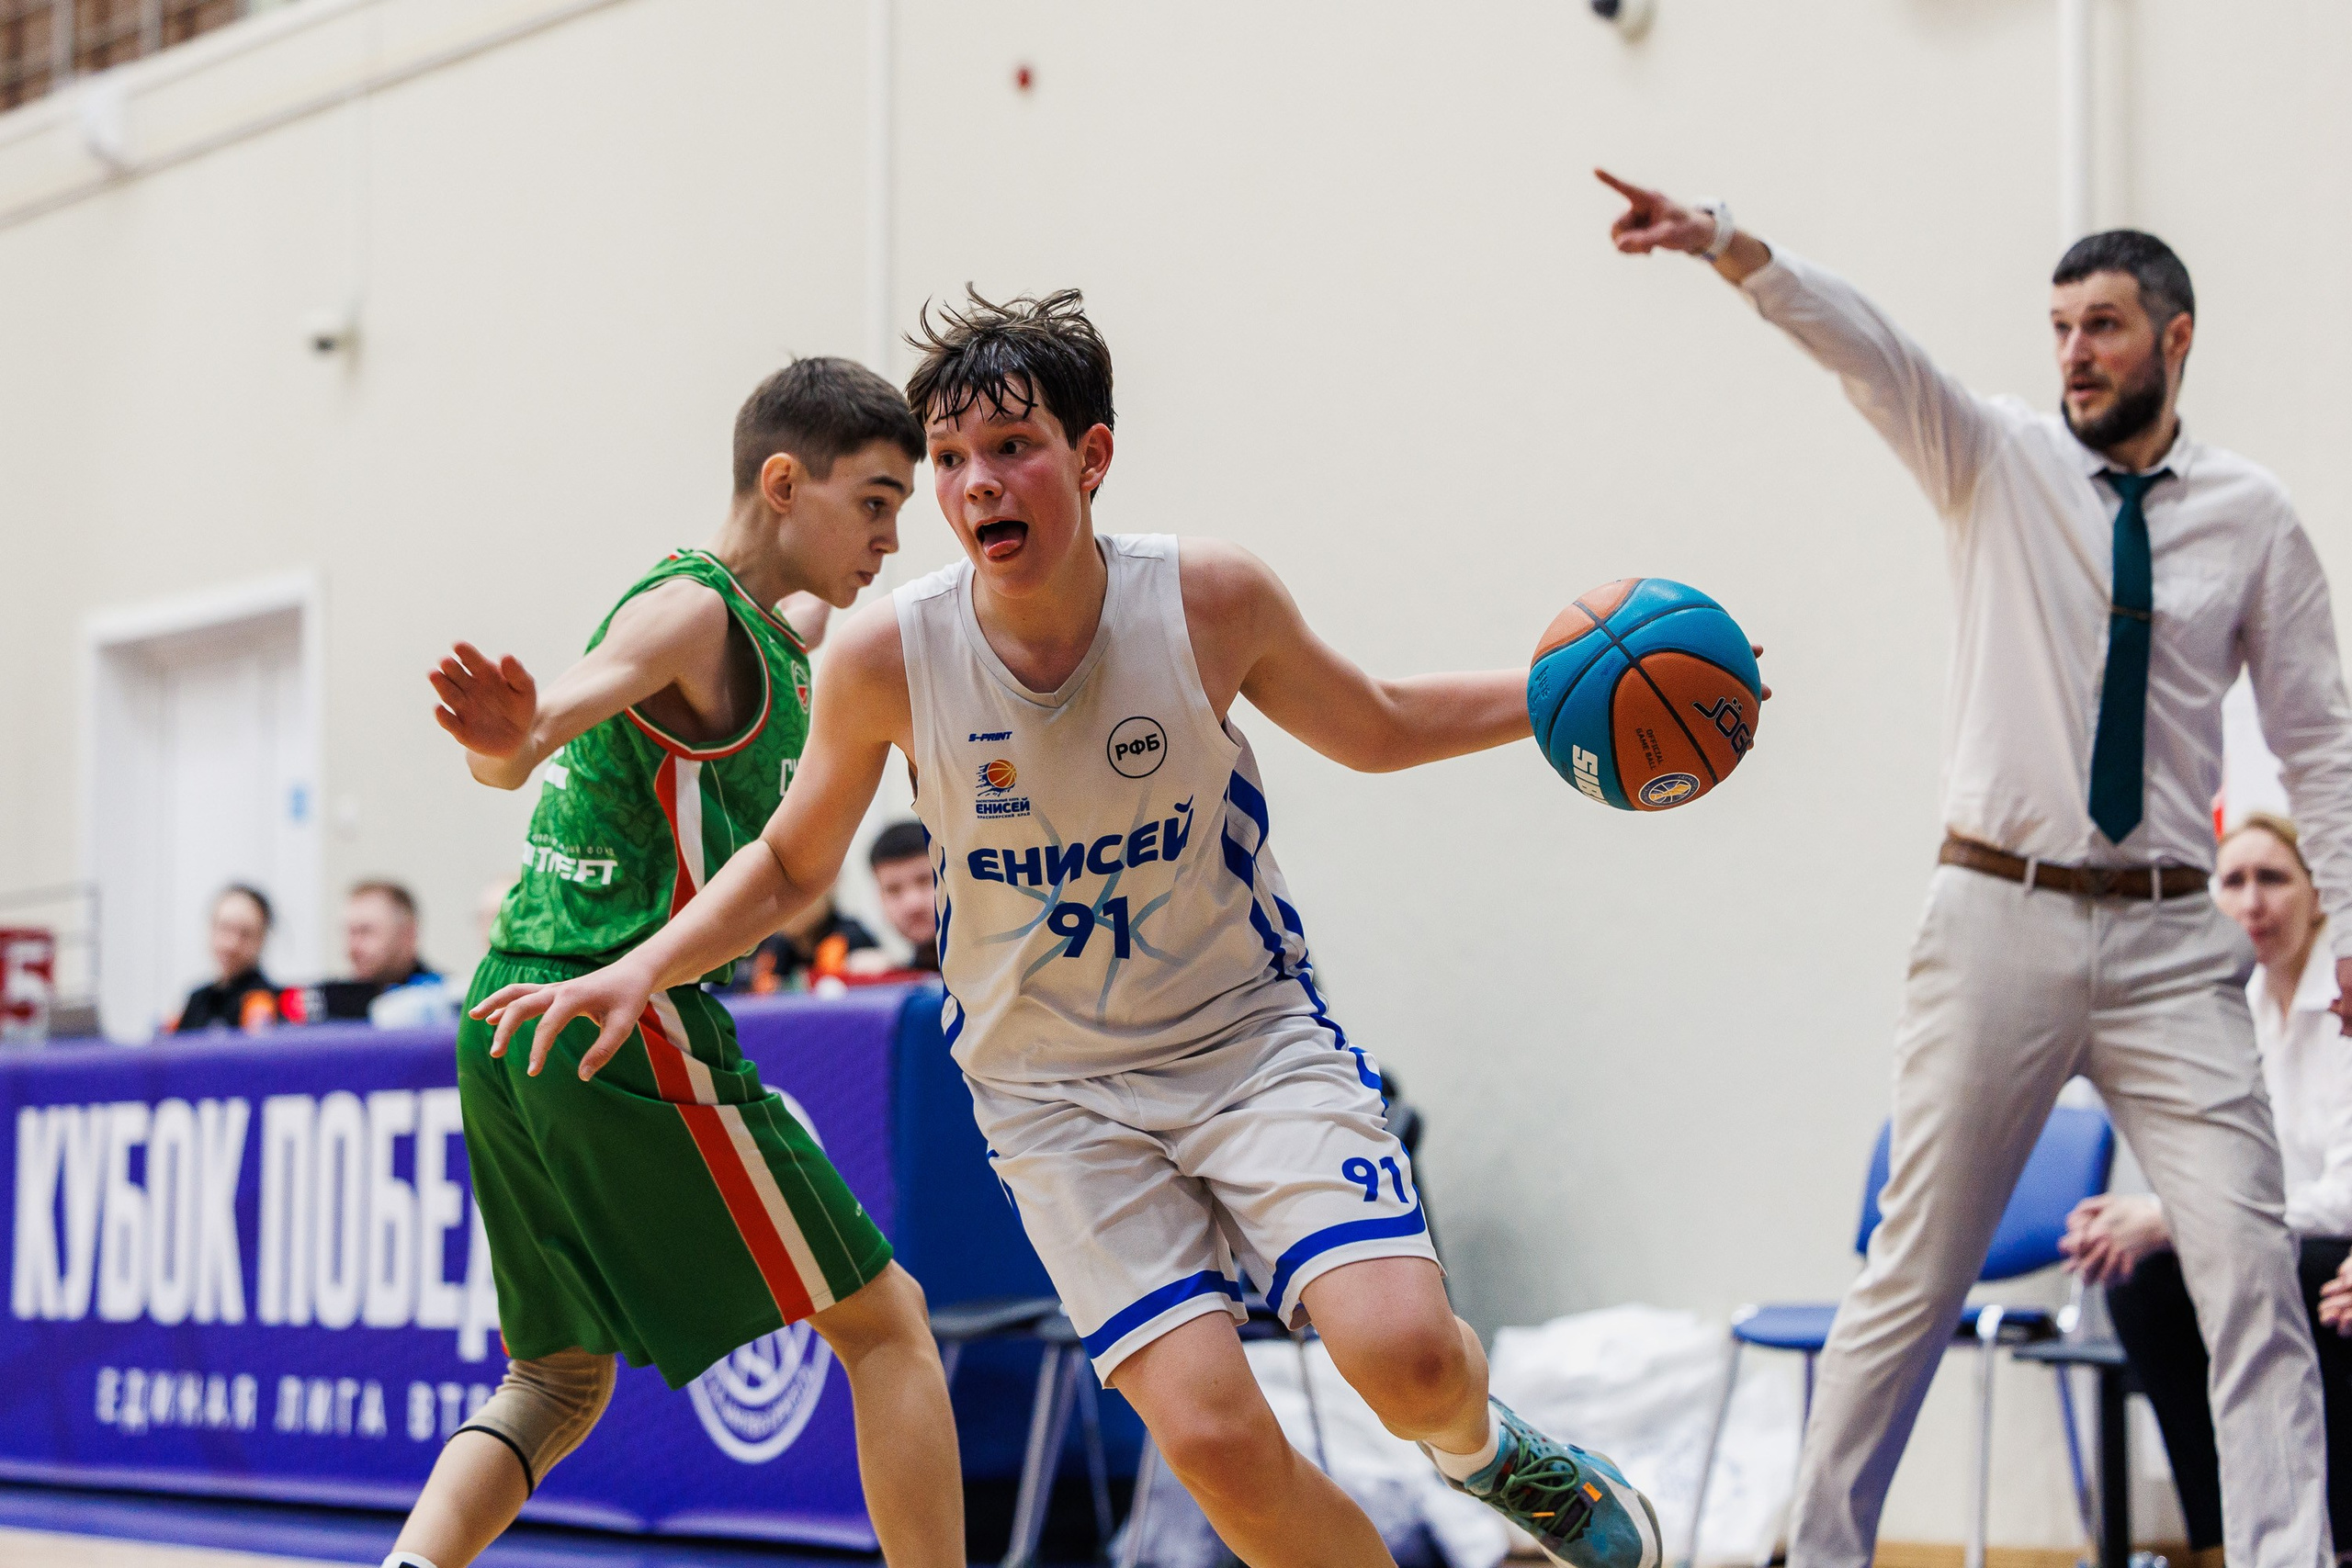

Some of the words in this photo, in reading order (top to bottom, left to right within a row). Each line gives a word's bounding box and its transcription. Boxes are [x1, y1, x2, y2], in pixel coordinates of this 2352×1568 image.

[967, 730, 1013, 742] S-PRINT
[1114, 733, 1161, 761] РФБ
[1635, 728, 1648, 751] GAME
[1645, 751, 1657, 771] BALL
[1645, 728, 1665, 765] OFFICIAL
[1691, 696, 1753, 766] JÖG
[1572, 744, 1610, 807] SIB
[976, 796, 1031, 815] ЕНИСЕЙ
[967, 794, 1194, 887] ЕНИСЕЙ
[1046, 895, 1132, 960] 91
[1341, 1156, 1410, 1204] 91
[10, 1099, 250, 1326] КУБОК
[96, 1366, 258, 1437] ЕДИНАЯ
[276, 1374, 388, 1439] ЛИГА
